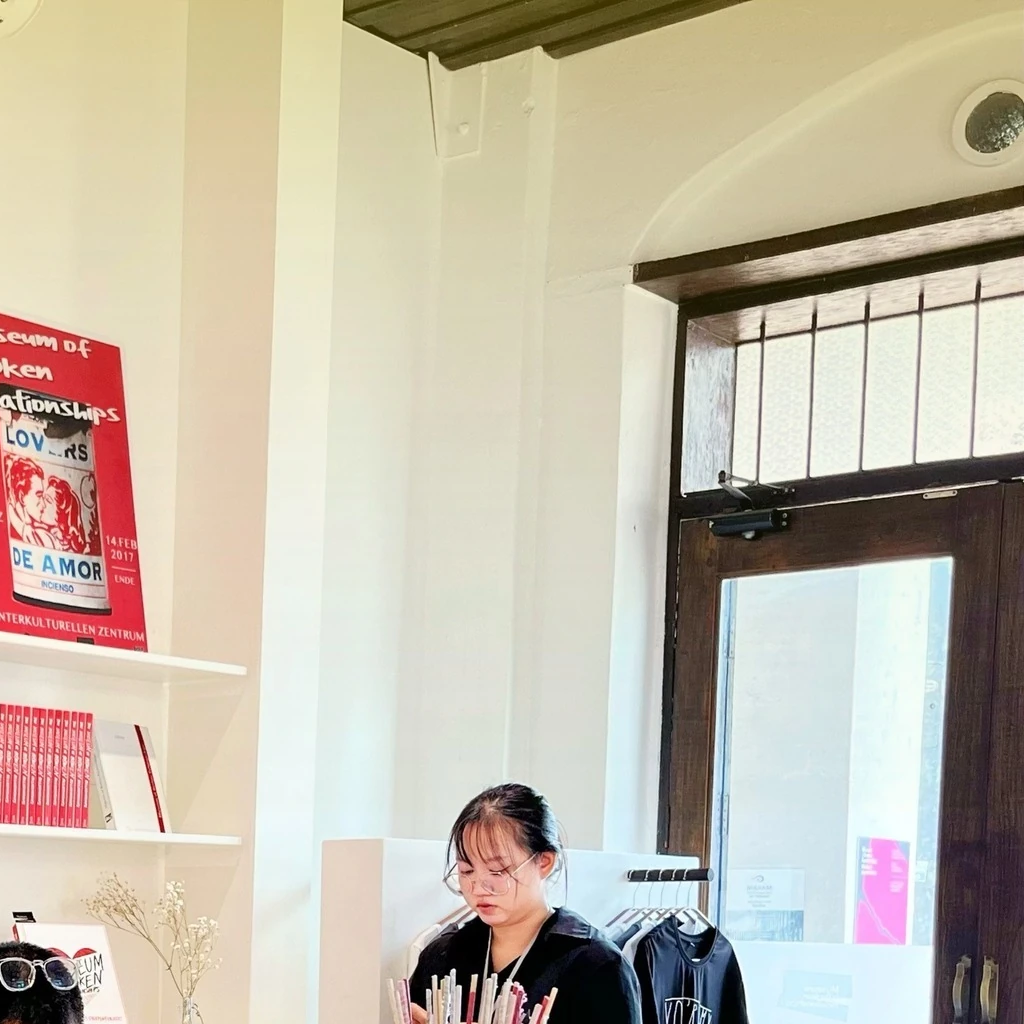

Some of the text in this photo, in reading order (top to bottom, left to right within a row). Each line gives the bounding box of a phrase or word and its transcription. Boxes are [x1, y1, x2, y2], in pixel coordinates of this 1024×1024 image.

[64, 340, 92, 359] of
[7, 426, 88, 462] LOVRS
[106, 535, 138, 550] 14.FEB
[111, 550, 134, 562] 2017
[13, 547, 103, 582] DE AMOR
[41, 580, 74, 594] INCIENSO
[114, 575, 135, 586] ENDE
[97, 626, 145, 643] ZENTRUM
